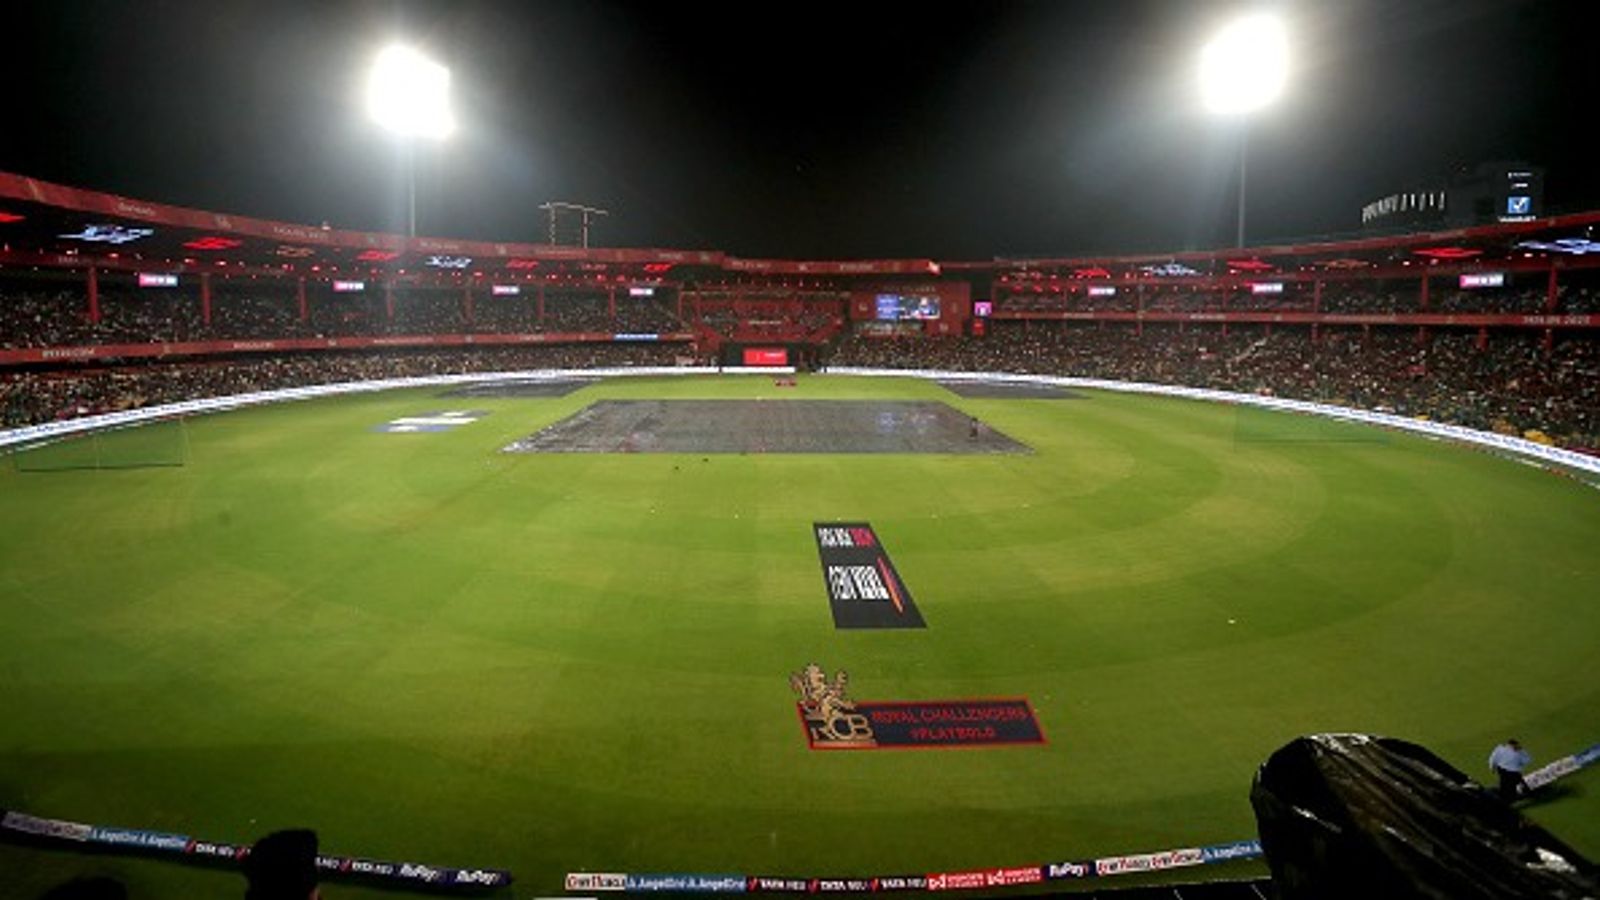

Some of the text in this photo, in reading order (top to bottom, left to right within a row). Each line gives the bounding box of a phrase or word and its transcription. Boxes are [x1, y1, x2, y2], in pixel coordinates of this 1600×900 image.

[872, 705, 1030, 724] ROYAL CHALLENGERS
[810, 713, 874, 742] RCB
